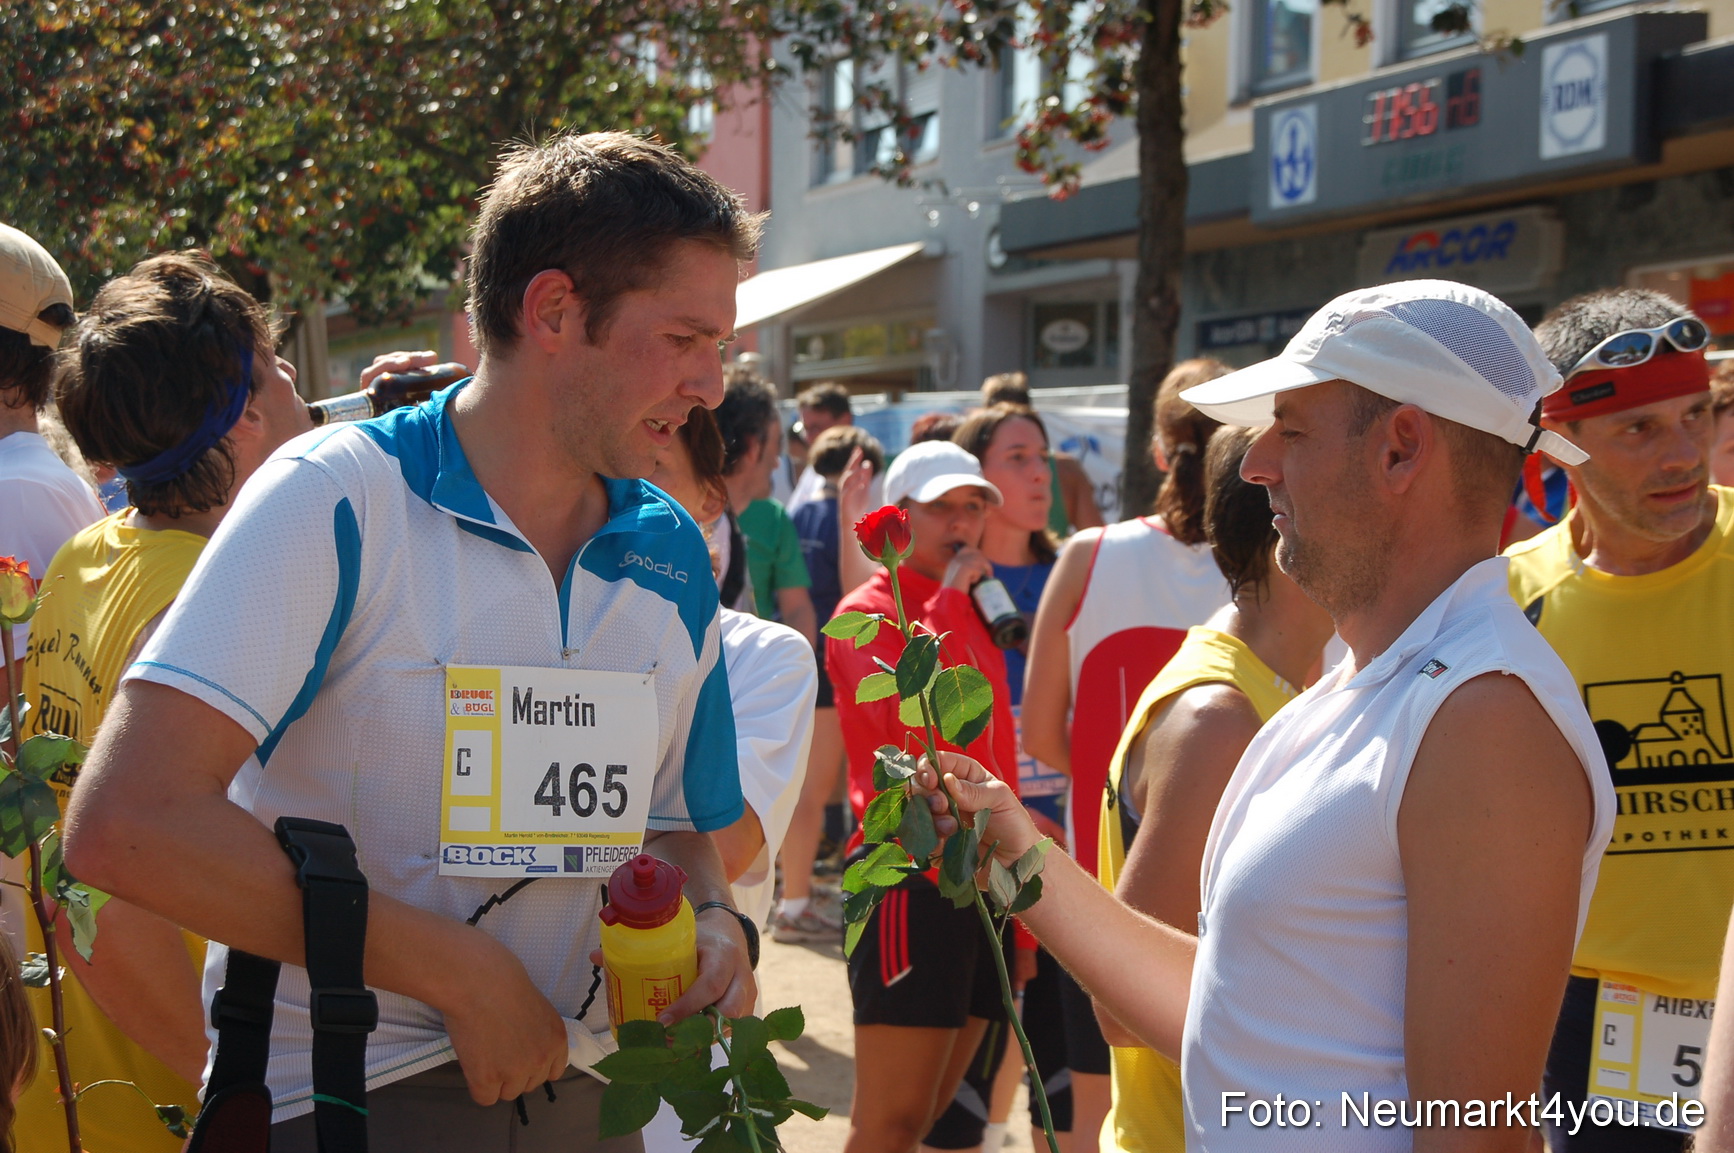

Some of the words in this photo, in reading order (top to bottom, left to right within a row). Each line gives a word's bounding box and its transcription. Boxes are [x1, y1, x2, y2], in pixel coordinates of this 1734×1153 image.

[1384, 220, 1517, 274] ARCOR
[512, 686, 596, 727] Martin
[456, 747, 472, 776] C
[533, 761, 629, 819] 465
[444, 845, 537, 866] BOCK
[586, 846, 639, 863] PFLEIDERER
[1603, 1023, 1617, 1046] C
